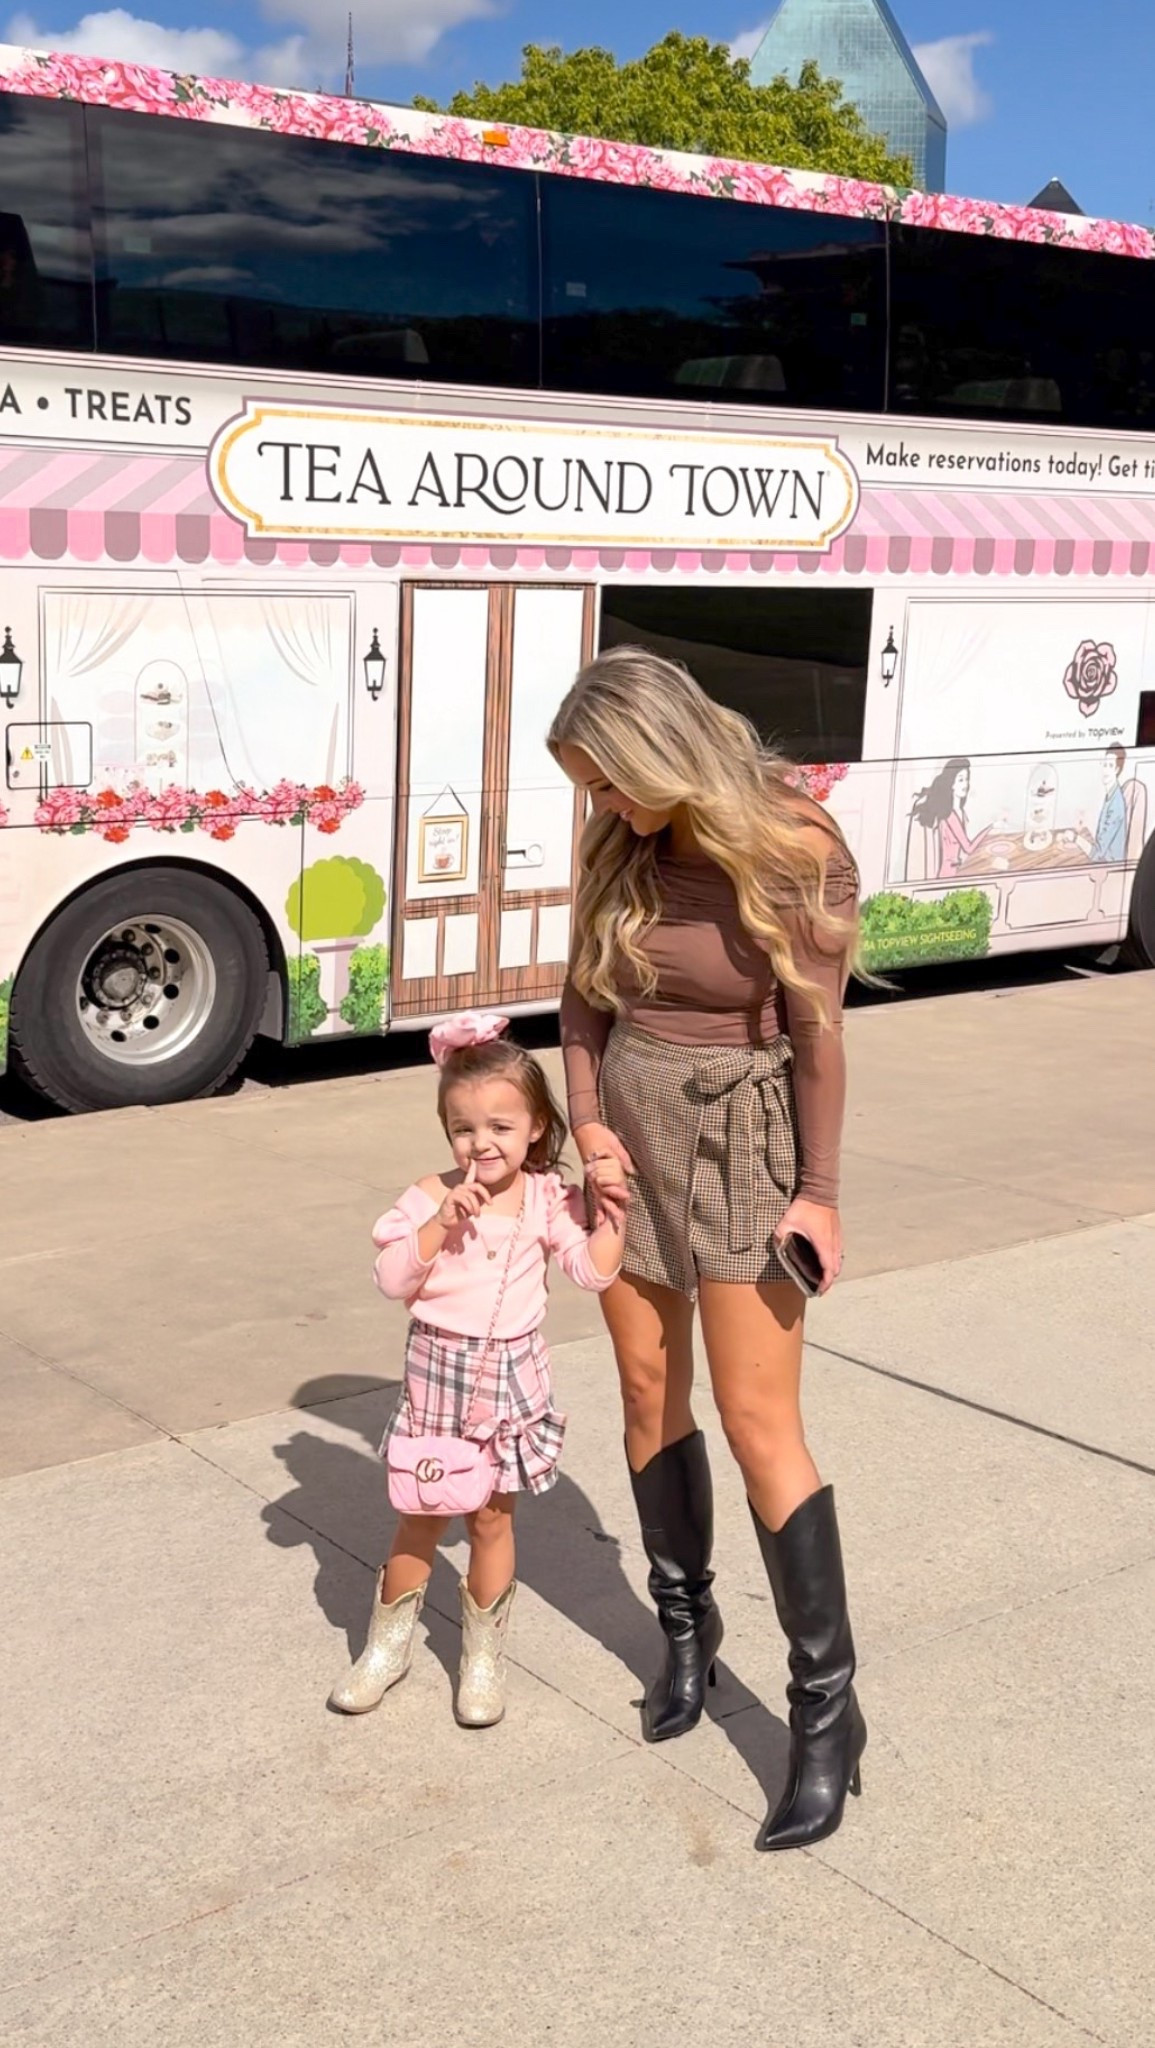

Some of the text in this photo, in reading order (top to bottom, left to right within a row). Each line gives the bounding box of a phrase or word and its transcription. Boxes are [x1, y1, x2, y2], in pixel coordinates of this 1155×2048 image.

[64, 387, 192, 426] TREATS
[257, 441, 825, 520] TEA AROUND TOWN
[866, 441, 920, 468] Make
[928, 451, 1041, 474] reservations
[1048, 451, 1103, 482] today!
[1108, 455, 1138, 478] Get
[1088, 727, 1125, 740] TOPVIEW
[877, 935, 918, 950] TOPVIEW
[920, 928, 977, 945] SIGHTSEEING
